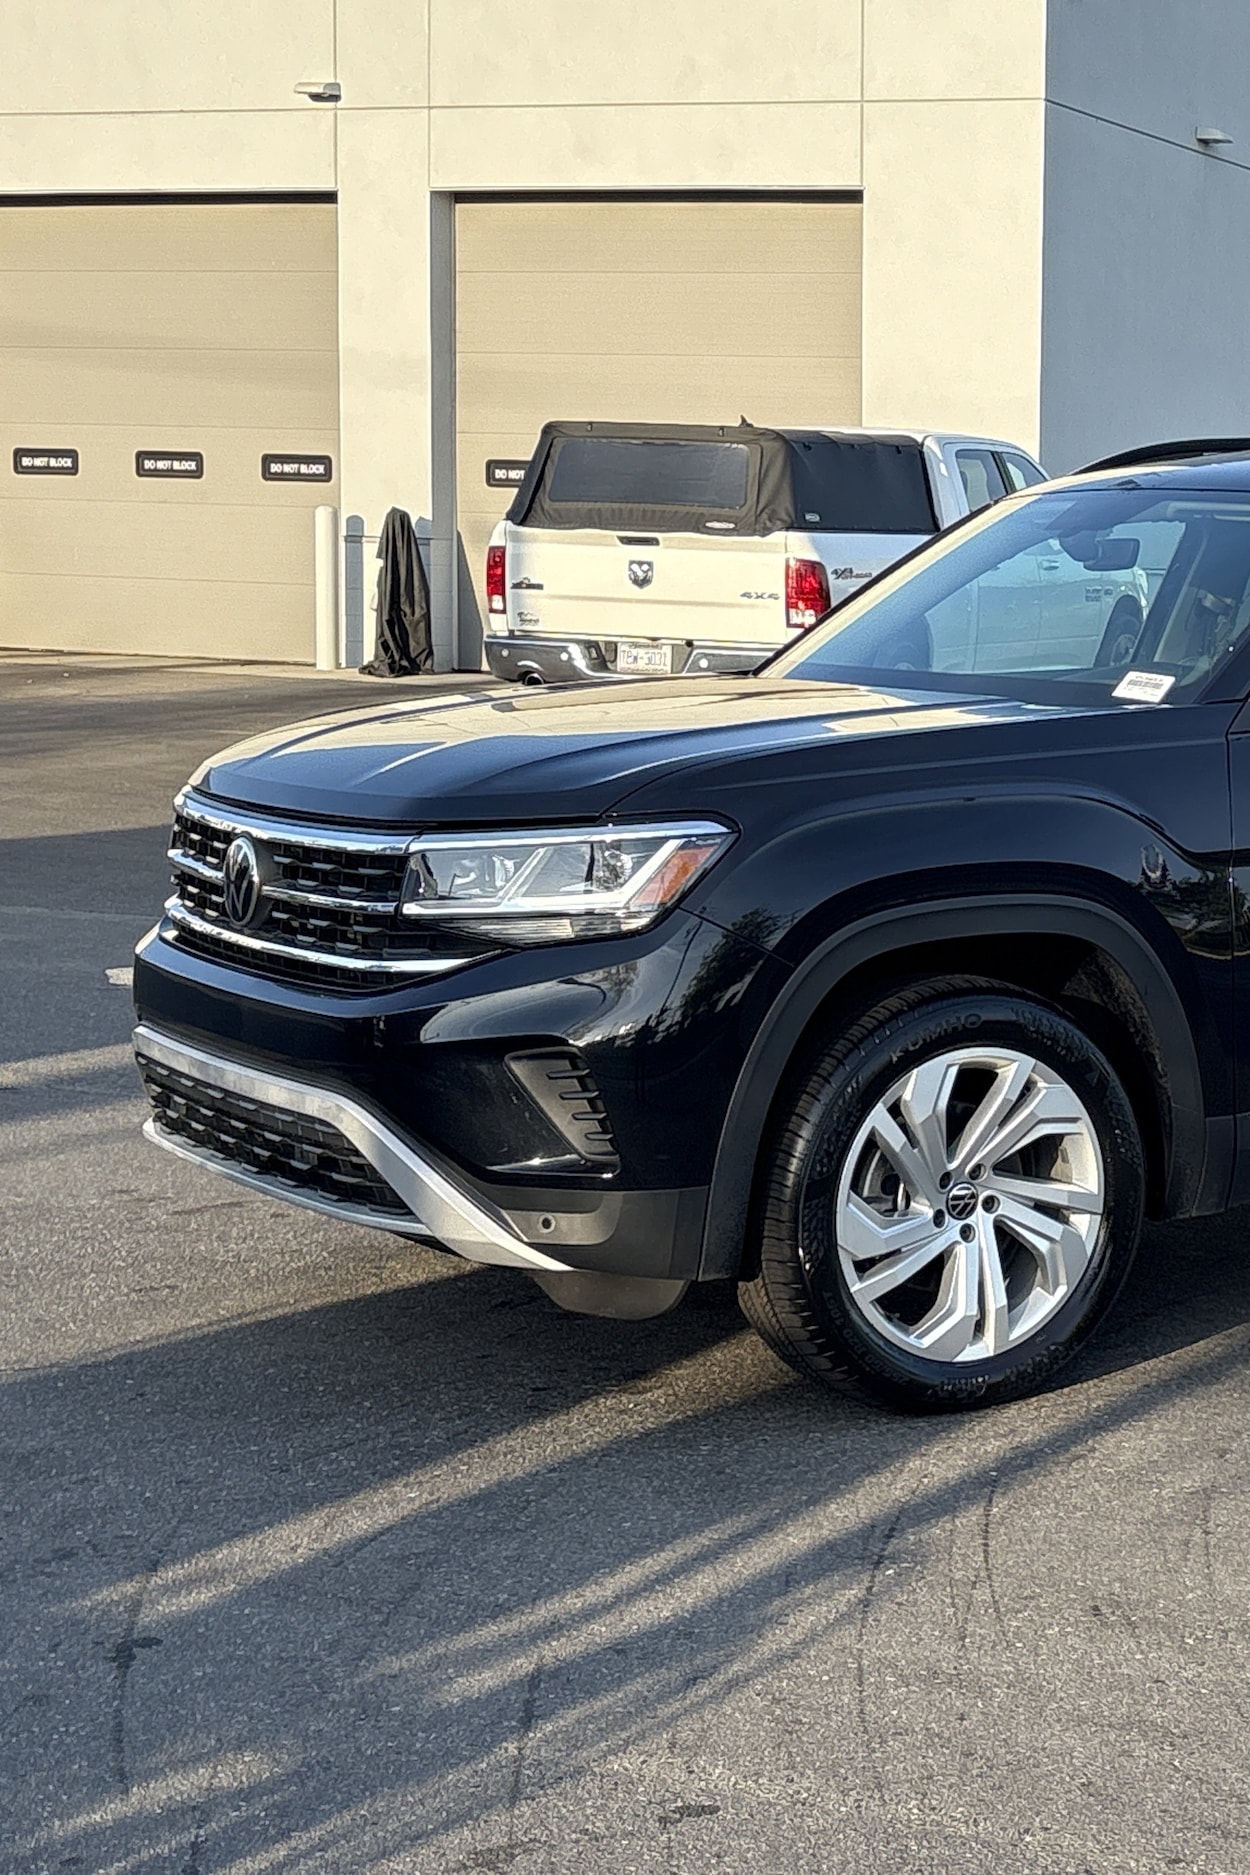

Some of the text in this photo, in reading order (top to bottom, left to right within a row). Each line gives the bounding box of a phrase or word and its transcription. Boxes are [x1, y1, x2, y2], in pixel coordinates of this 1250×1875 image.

[21, 457, 73, 468] DO NOT BLOCK
[144, 459, 197, 471] DO NOT BLOCK
[270, 463, 325, 475] DO NOT BLOCK
[494, 469, 525, 480] DO NOT
[889, 1012, 983, 1065] KUMHO
